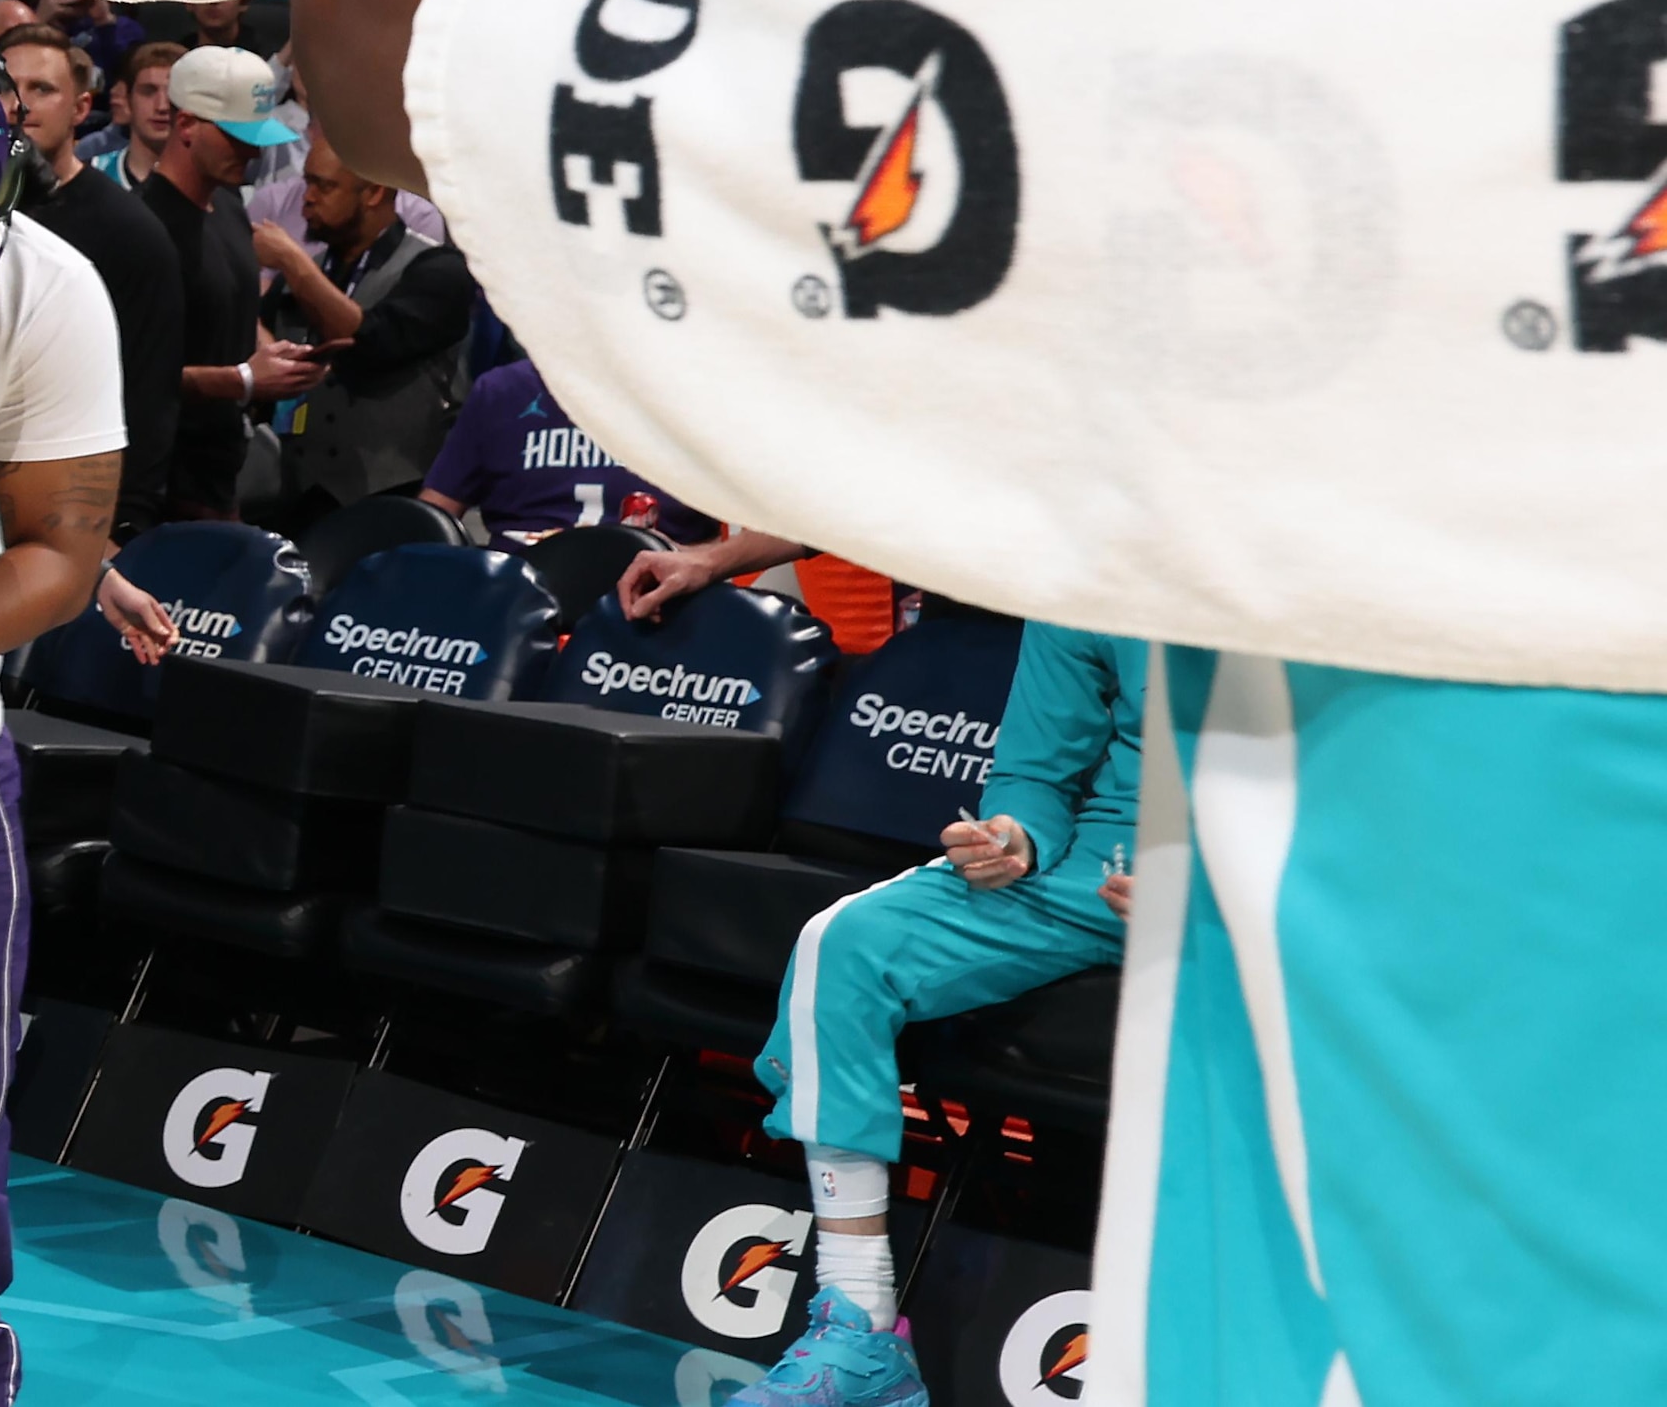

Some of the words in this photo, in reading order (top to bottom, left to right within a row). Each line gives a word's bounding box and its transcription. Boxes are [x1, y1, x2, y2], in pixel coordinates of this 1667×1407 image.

[325, 613, 480, 666] Spectrum
[353, 655, 468, 696] CENTER
[581, 651, 754, 707] Spectrum
[661, 702, 741, 729] CENTER
[849, 692, 1001, 750] Spectru
[885, 741, 995, 785] CENTE
[162, 1066, 274, 1189] G
[399, 1127, 528, 1256] G
[680, 1202, 813, 1339] G
